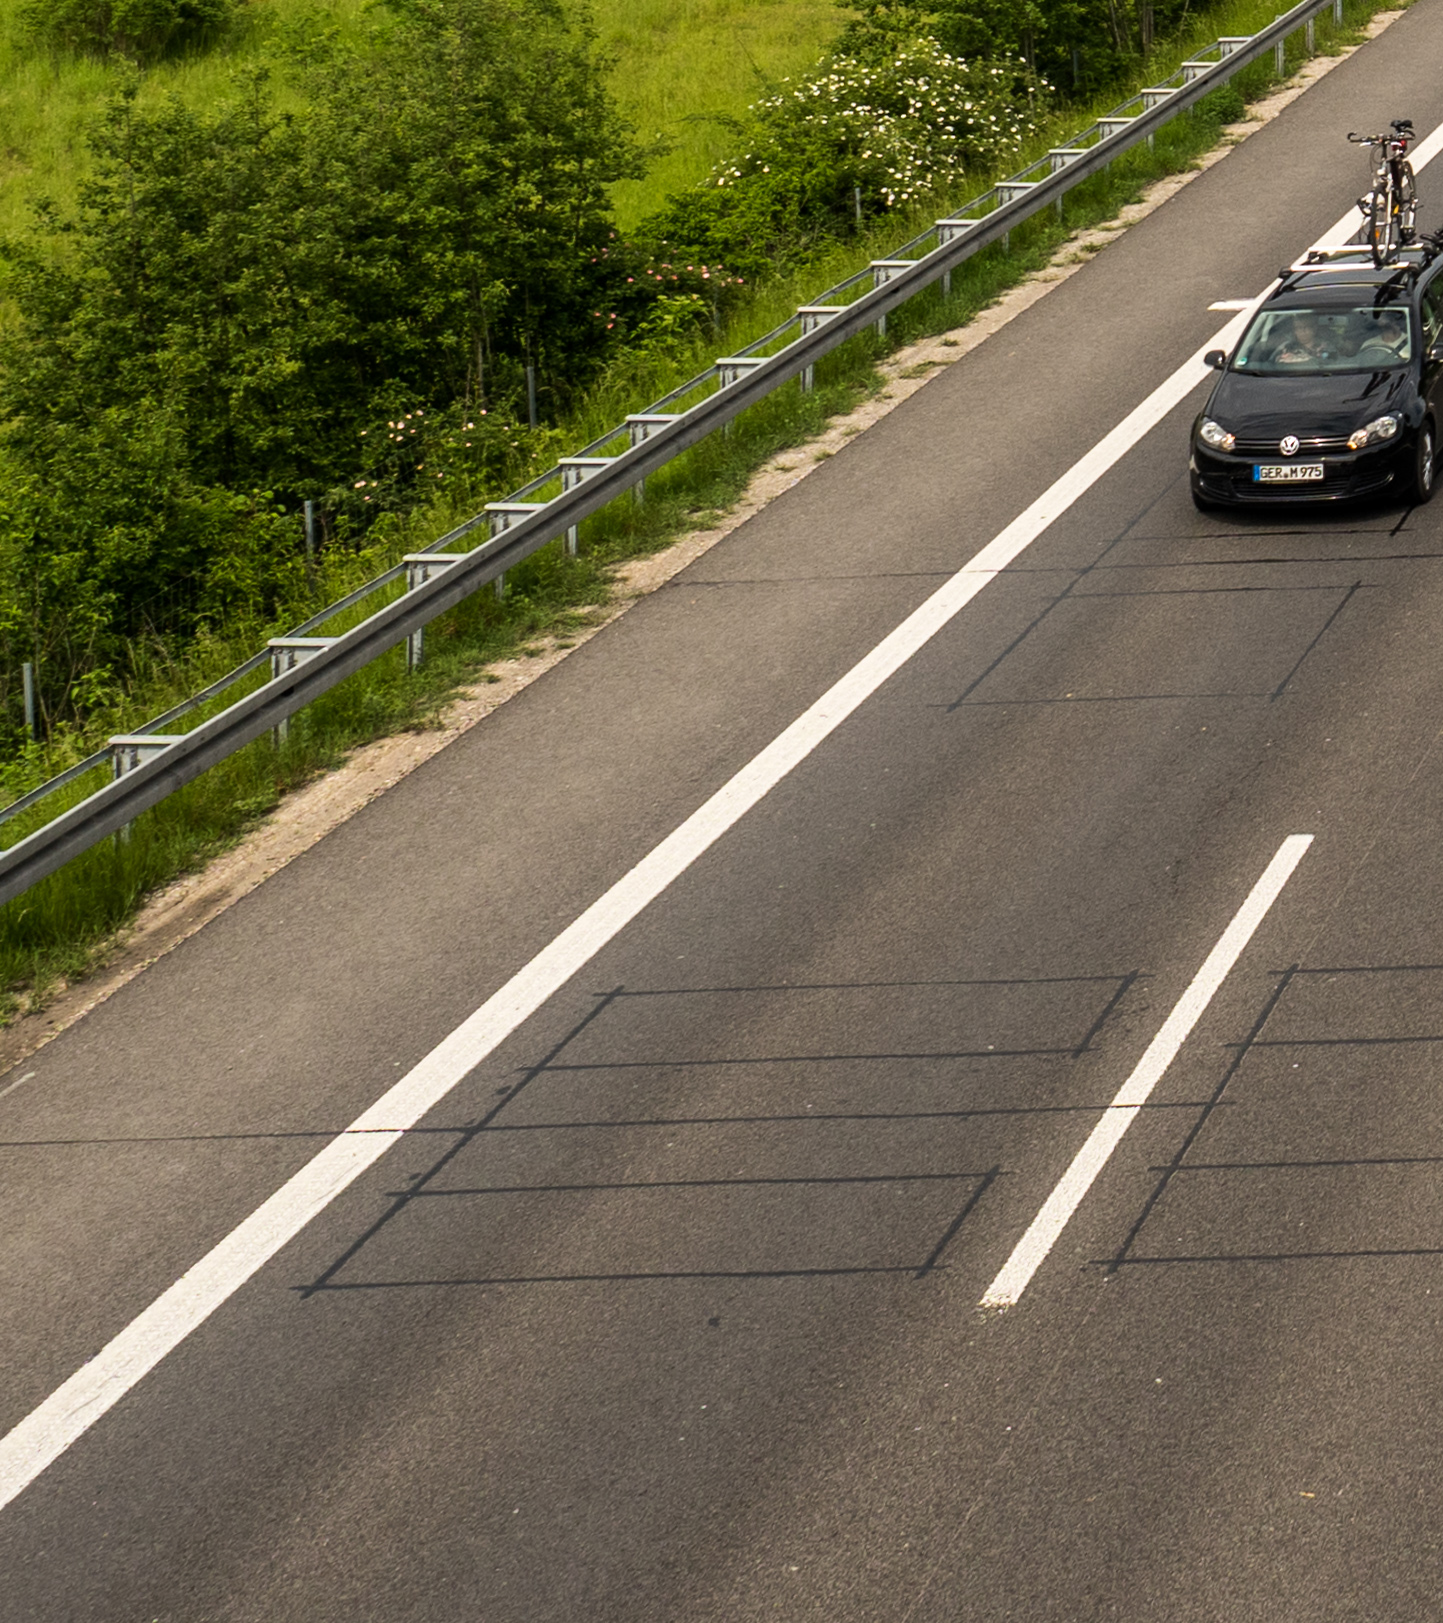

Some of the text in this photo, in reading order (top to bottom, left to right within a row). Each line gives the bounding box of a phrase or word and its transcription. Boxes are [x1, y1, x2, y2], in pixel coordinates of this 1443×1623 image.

[1260, 466, 1322, 479] GER M 975
